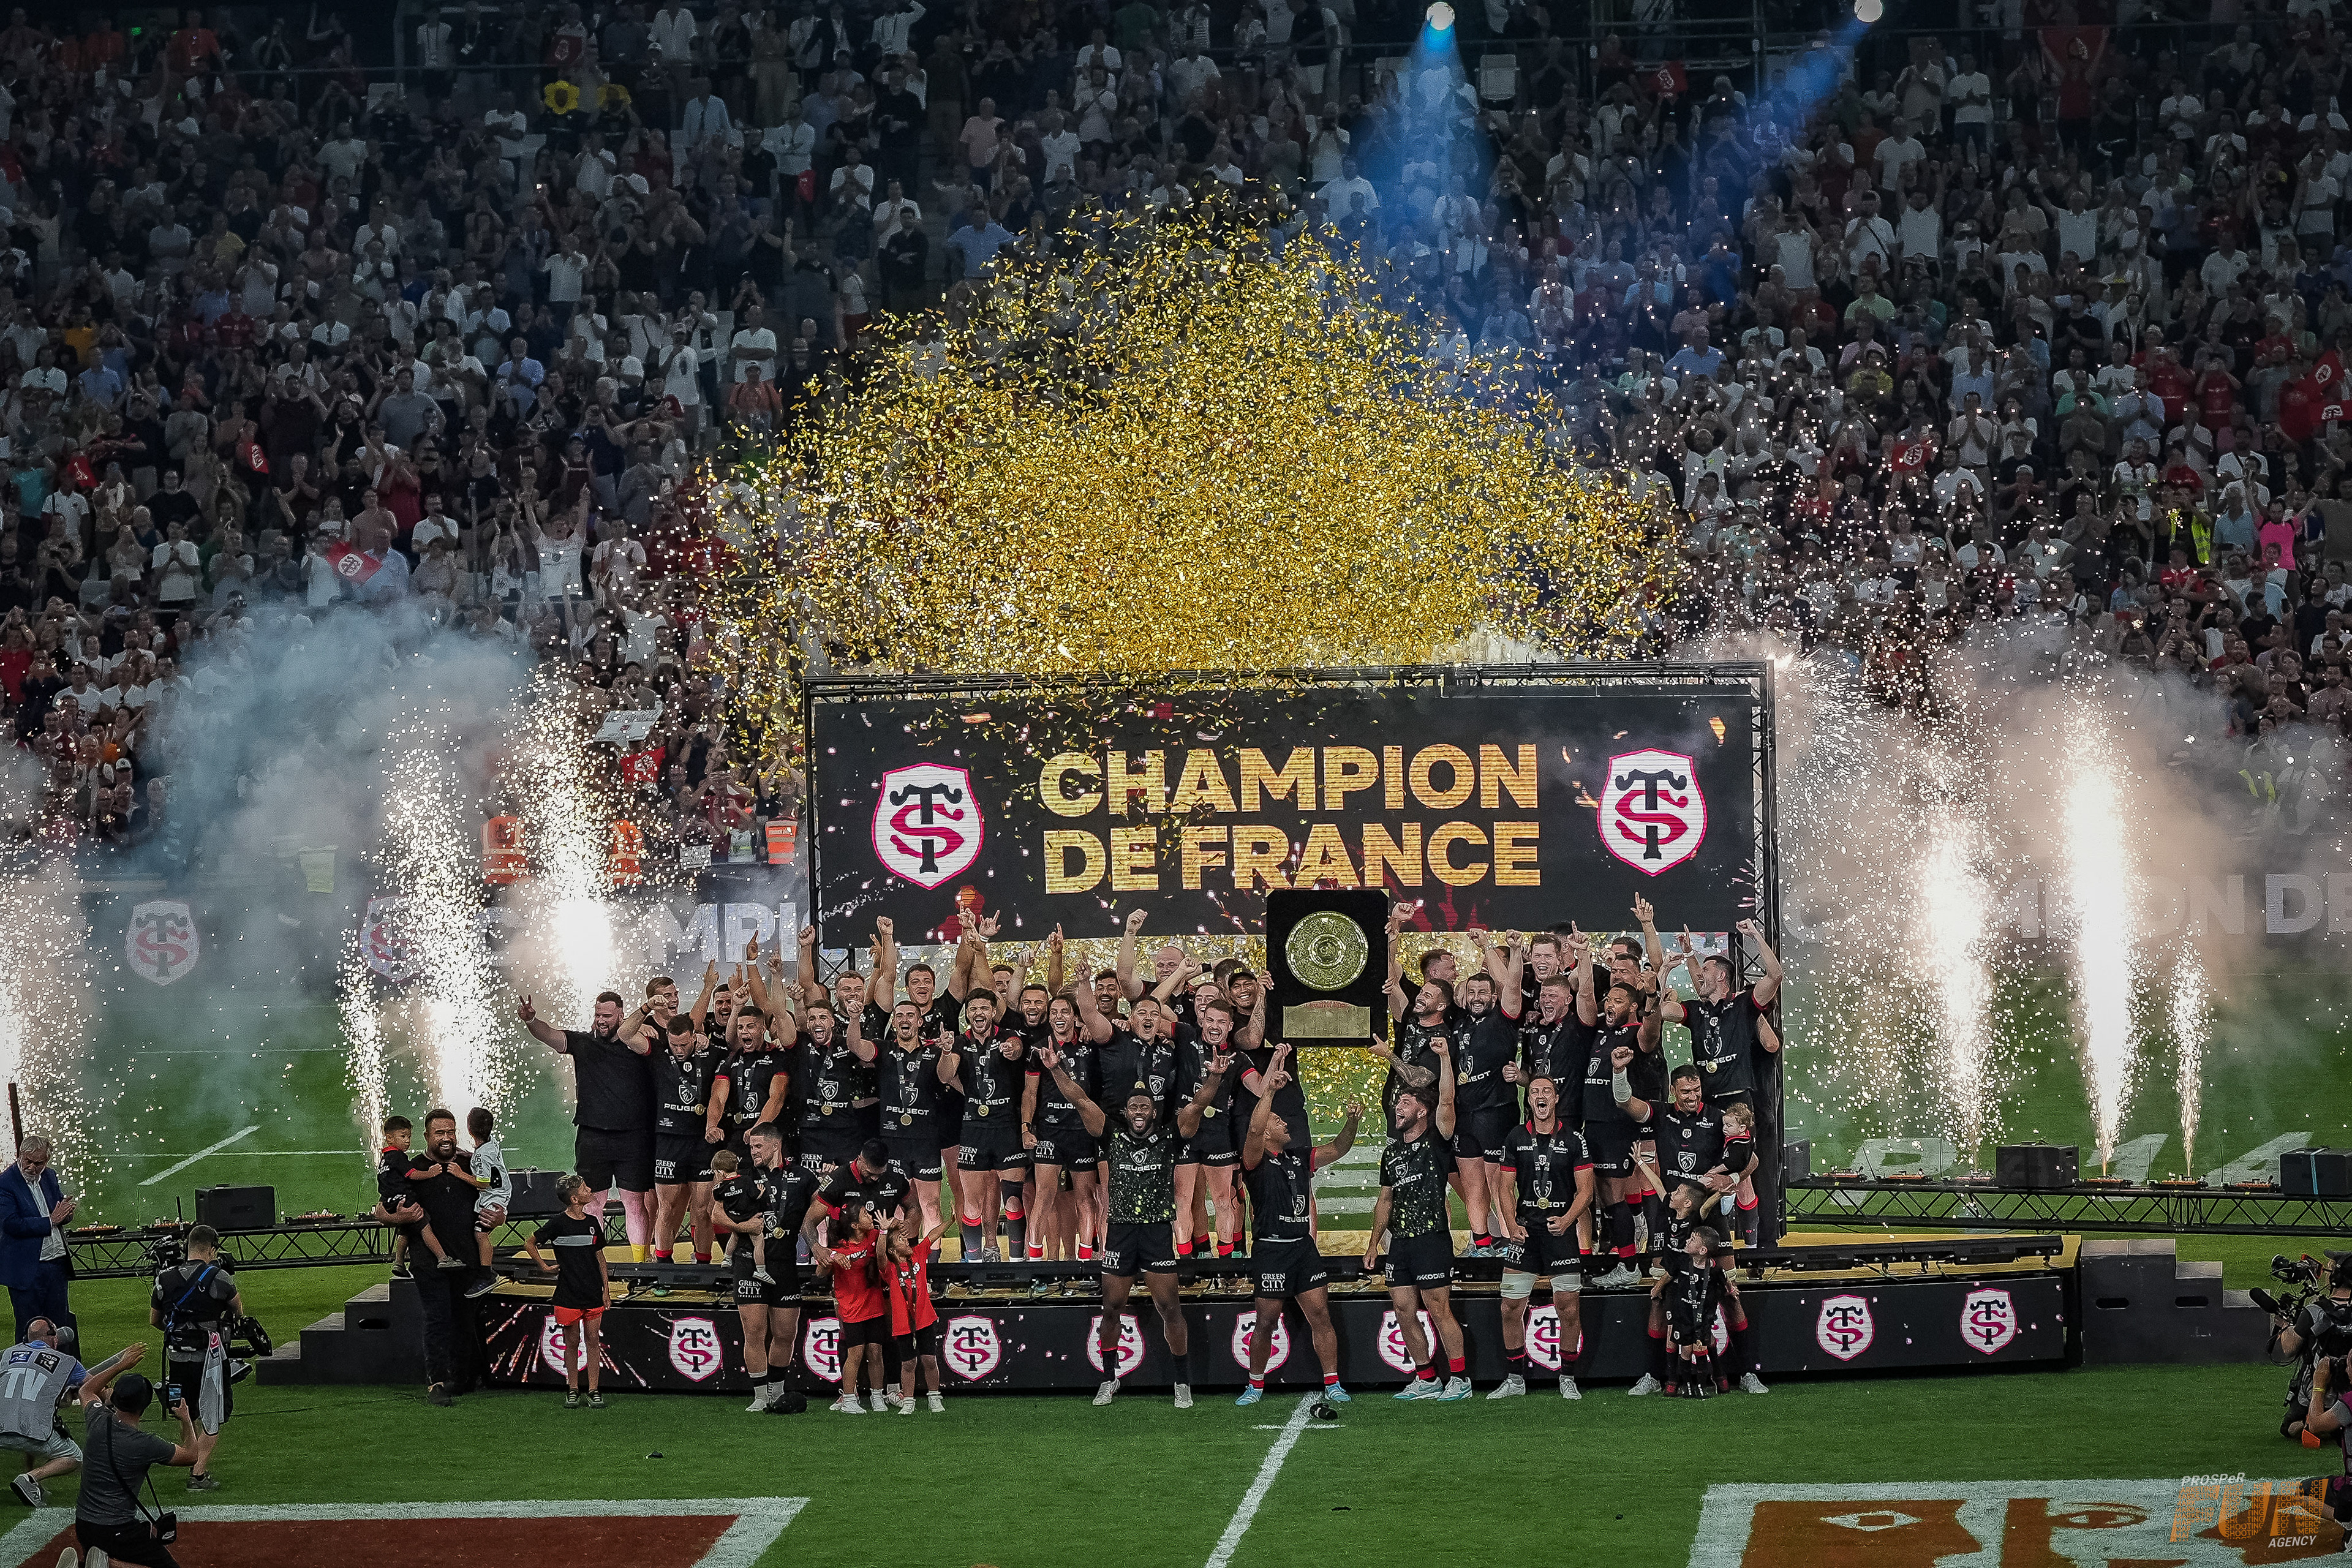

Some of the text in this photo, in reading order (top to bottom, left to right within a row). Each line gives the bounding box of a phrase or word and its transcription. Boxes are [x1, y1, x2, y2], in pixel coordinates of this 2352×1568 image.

[1039, 743, 1538, 818] CHAMPION
[1043, 821, 1542, 894] DE FRANCE
[968, 1097, 1011, 1106] PEGEOT
[1036, 1147, 1055, 1156] CITY
[801, 1153, 823, 1161] GREEN
[655, 1159, 676, 1167] GREEN
[655, 1166, 676, 1176] CITY
[1416, 1272, 1445, 1281] AKKODIS
[1261, 1279, 1285, 1289] CITY
[738, 1286, 761, 1295] CITY
[4, 1368, 48, 1401] TV
